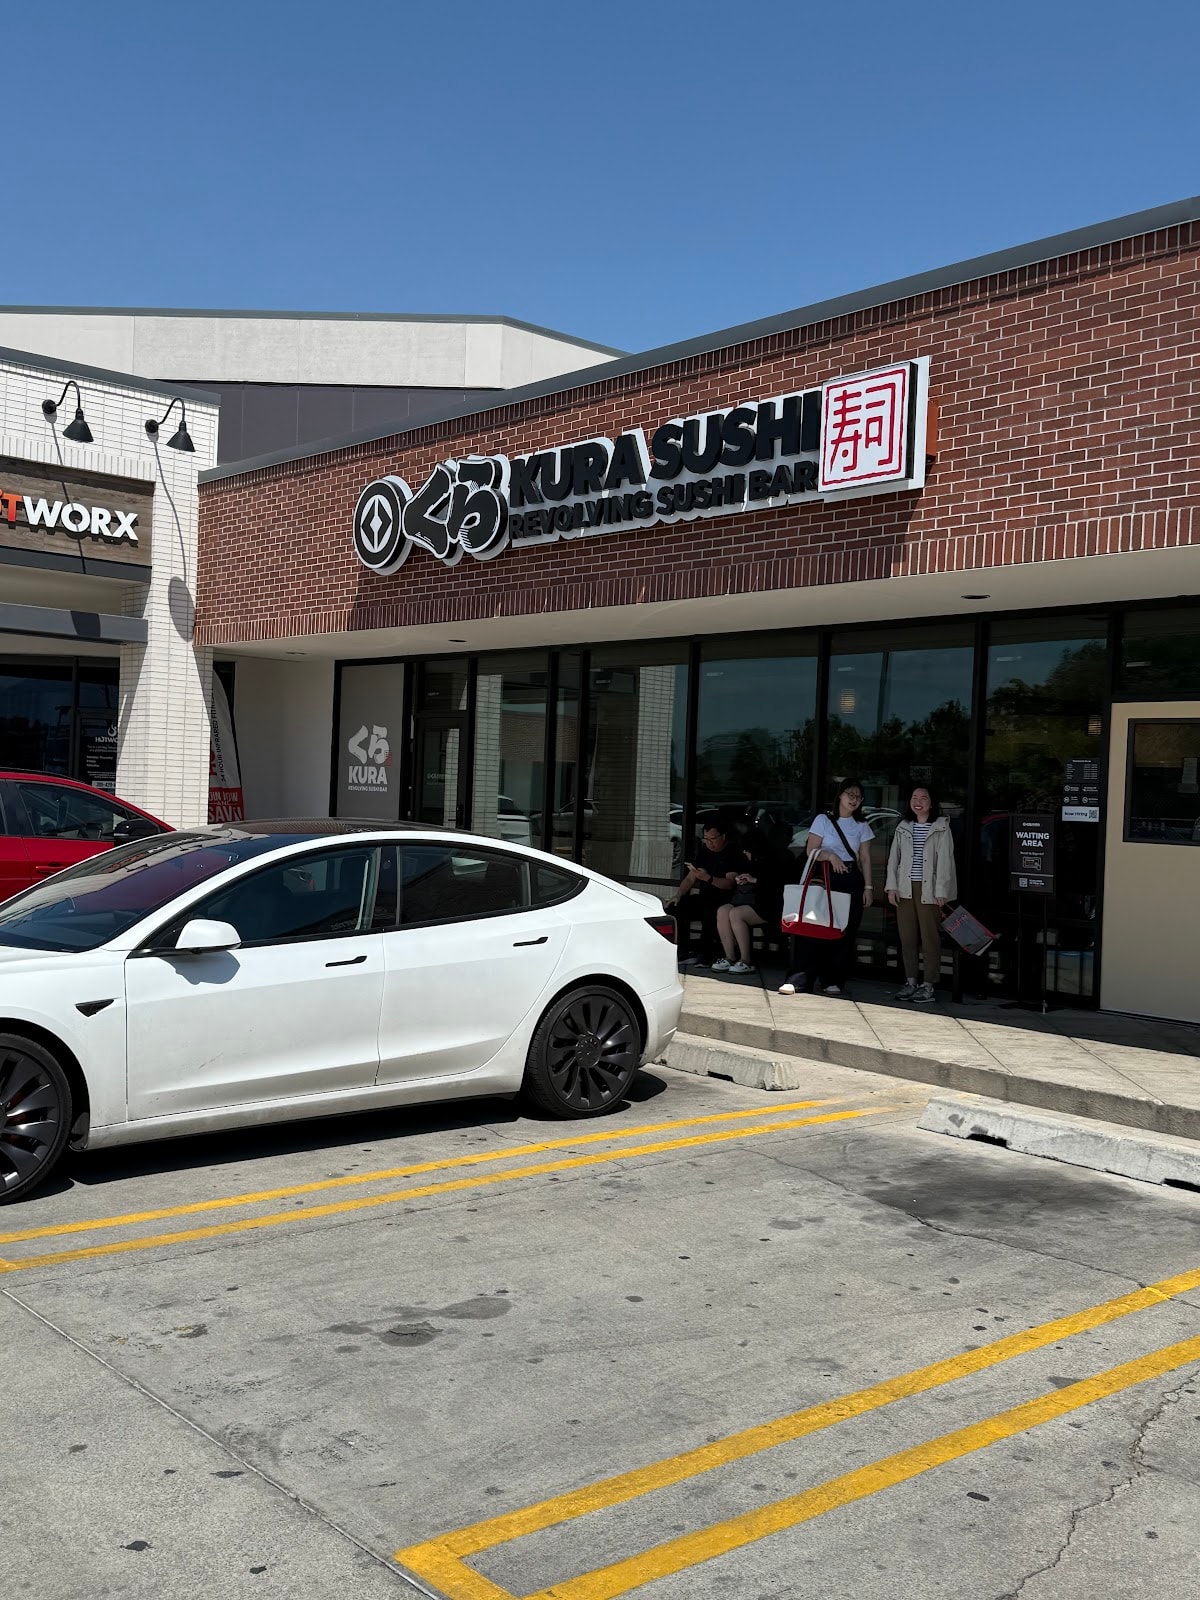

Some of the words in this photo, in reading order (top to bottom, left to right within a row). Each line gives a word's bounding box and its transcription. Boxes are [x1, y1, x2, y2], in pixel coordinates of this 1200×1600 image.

[510, 432, 647, 508] KURA
[649, 390, 821, 480] SUSHI
[0, 488, 139, 541] TWORX
[402, 458, 509, 560] くら
[509, 488, 653, 540] REVOLVING
[656, 473, 746, 516] SUSHI
[749, 460, 819, 501] BAR
[212, 720, 221, 753] INFRARED
[348, 724, 390, 765] くら
[216, 754, 224, 773] HOUR
[348, 765, 388, 785] KURA
[1015, 831, 1050, 840] WAITING
[1021, 839, 1044, 848] AREA
